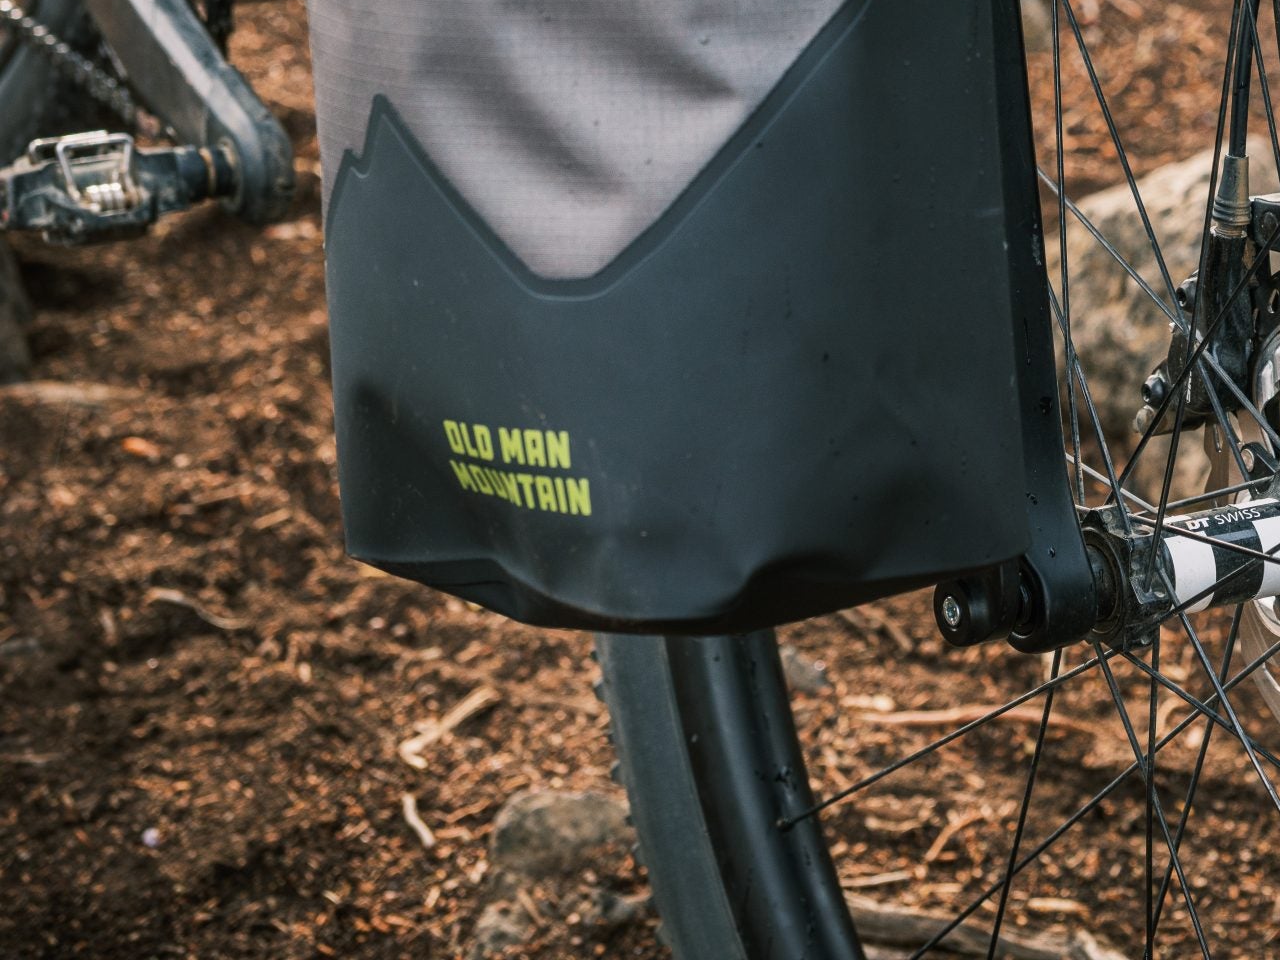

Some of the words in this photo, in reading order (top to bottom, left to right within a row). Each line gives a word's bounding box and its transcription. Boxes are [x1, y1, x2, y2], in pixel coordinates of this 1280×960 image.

[443, 419, 494, 461] OLD
[498, 426, 571, 469] MAN
[449, 459, 592, 516] MOUNTAIN
[1185, 517, 1210, 531] DT
[1214, 508, 1261, 525] SWISS
